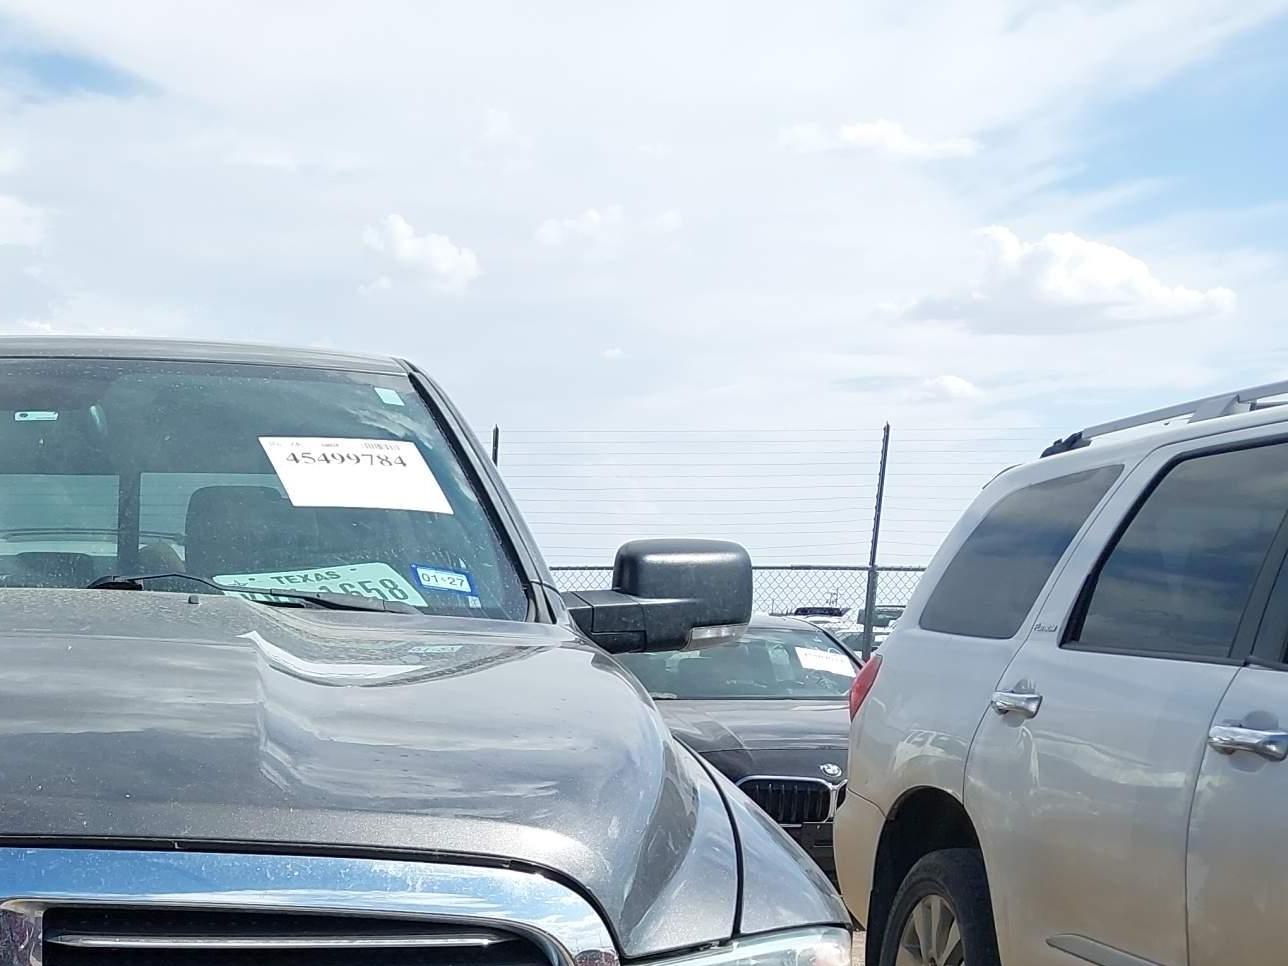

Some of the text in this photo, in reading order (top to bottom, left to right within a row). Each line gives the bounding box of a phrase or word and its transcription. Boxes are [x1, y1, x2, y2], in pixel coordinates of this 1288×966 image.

[285, 452, 408, 468] 45499784
[270, 570, 342, 586] TEXAS
[318, 578, 409, 601] 658
